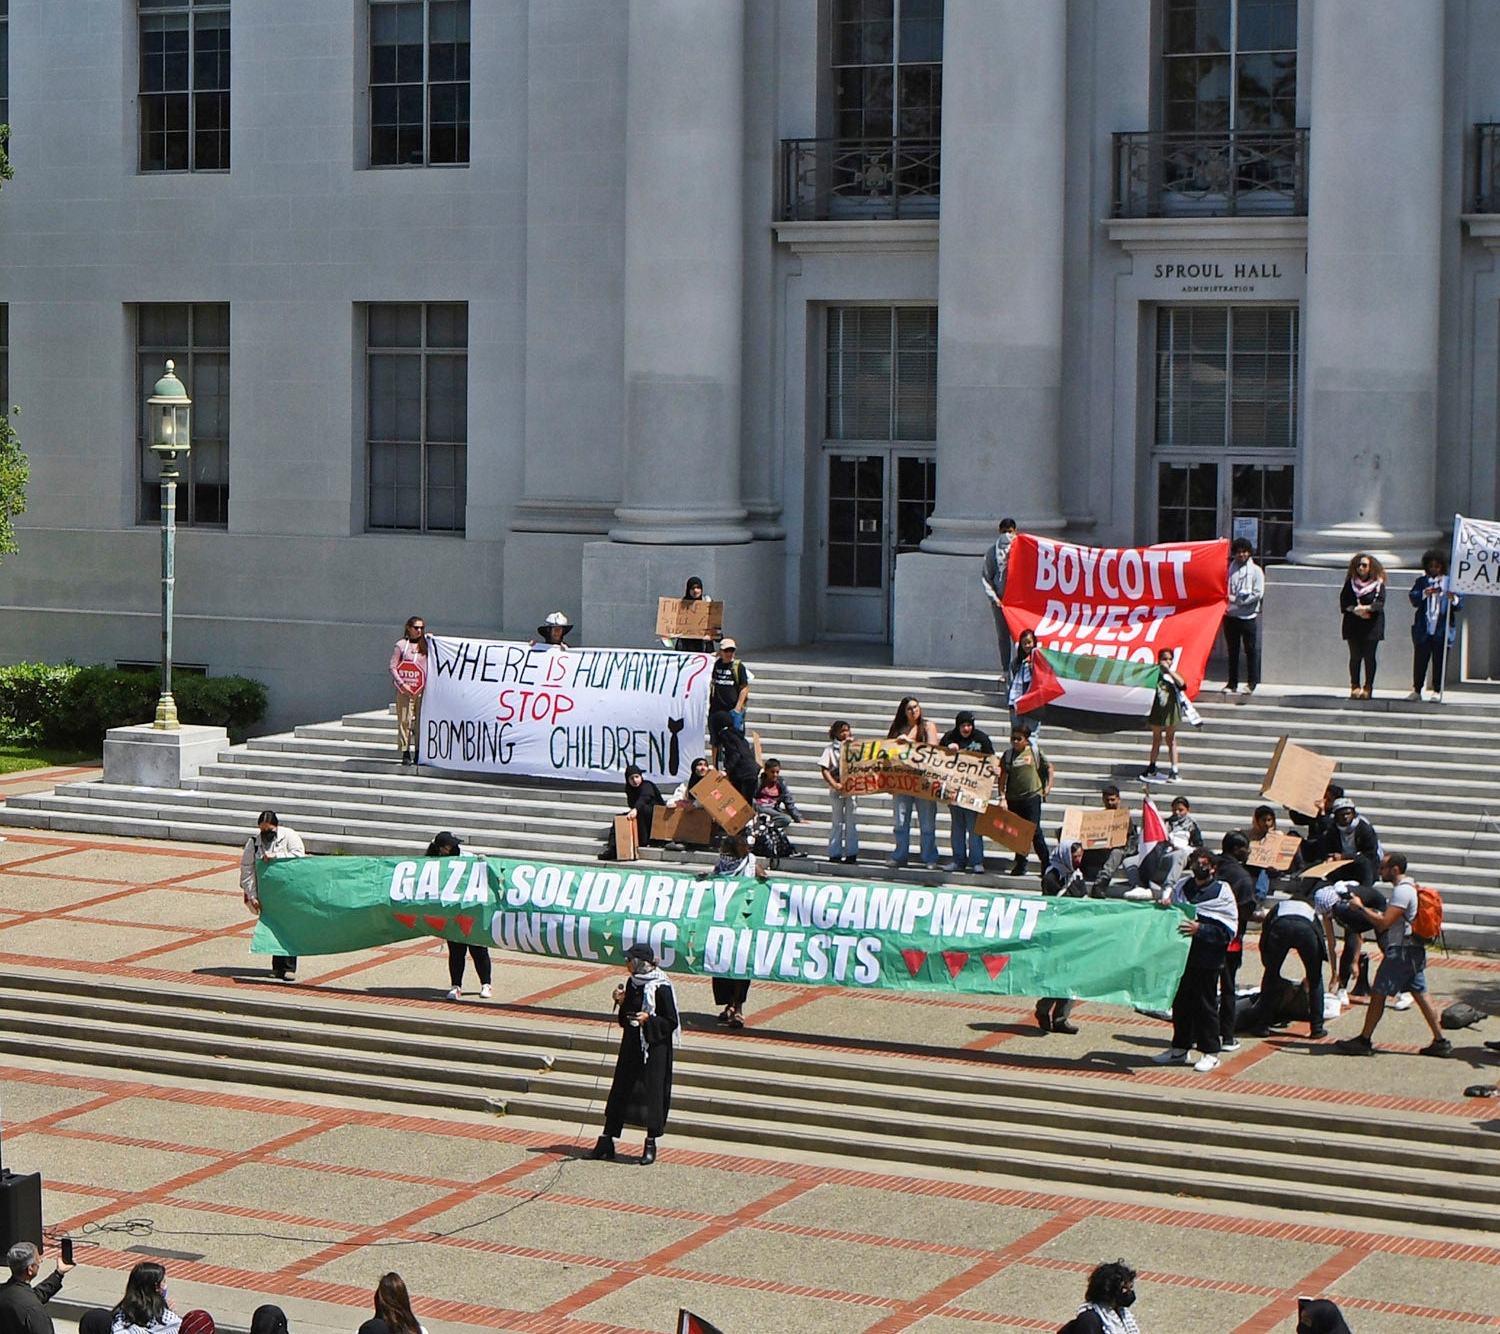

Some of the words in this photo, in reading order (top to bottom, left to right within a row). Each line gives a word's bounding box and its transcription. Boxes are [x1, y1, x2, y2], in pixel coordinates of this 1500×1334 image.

[1154, 264, 1224, 278] SPROUL
[1234, 264, 1282, 278] HALL
[1181, 285, 1255, 293] ADMINISTRATION
[1035, 540, 1192, 601] BOYCOTT
[1466, 548, 1500, 564] FOR
[1034, 599, 1176, 642] DIVEST
[399, 670, 420, 679] STOP
[431, 637, 548, 687] WHERE
[545, 655, 568, 682] IS
[572, 651, 708, 699] HUMANITY?
[497, 689, 575, 725] STOP
[427, 720, 517, 765] BOMBING
[549, 725, 665, 775] CHILDREN
[911, 745, 995, 779] Students
[844, 773, 920, 793] GENOCIDE
[389, 860, 488, 903] GAZA
[506, 864, 740, 922] SOLIDARITY
[765, 882, 1047, 941] ENCAMPMENT
[491, 910, 599, 960] UNTIL
[622, 918, 678, 968] UC
[703, 926, 882, 984] DIVESTS
